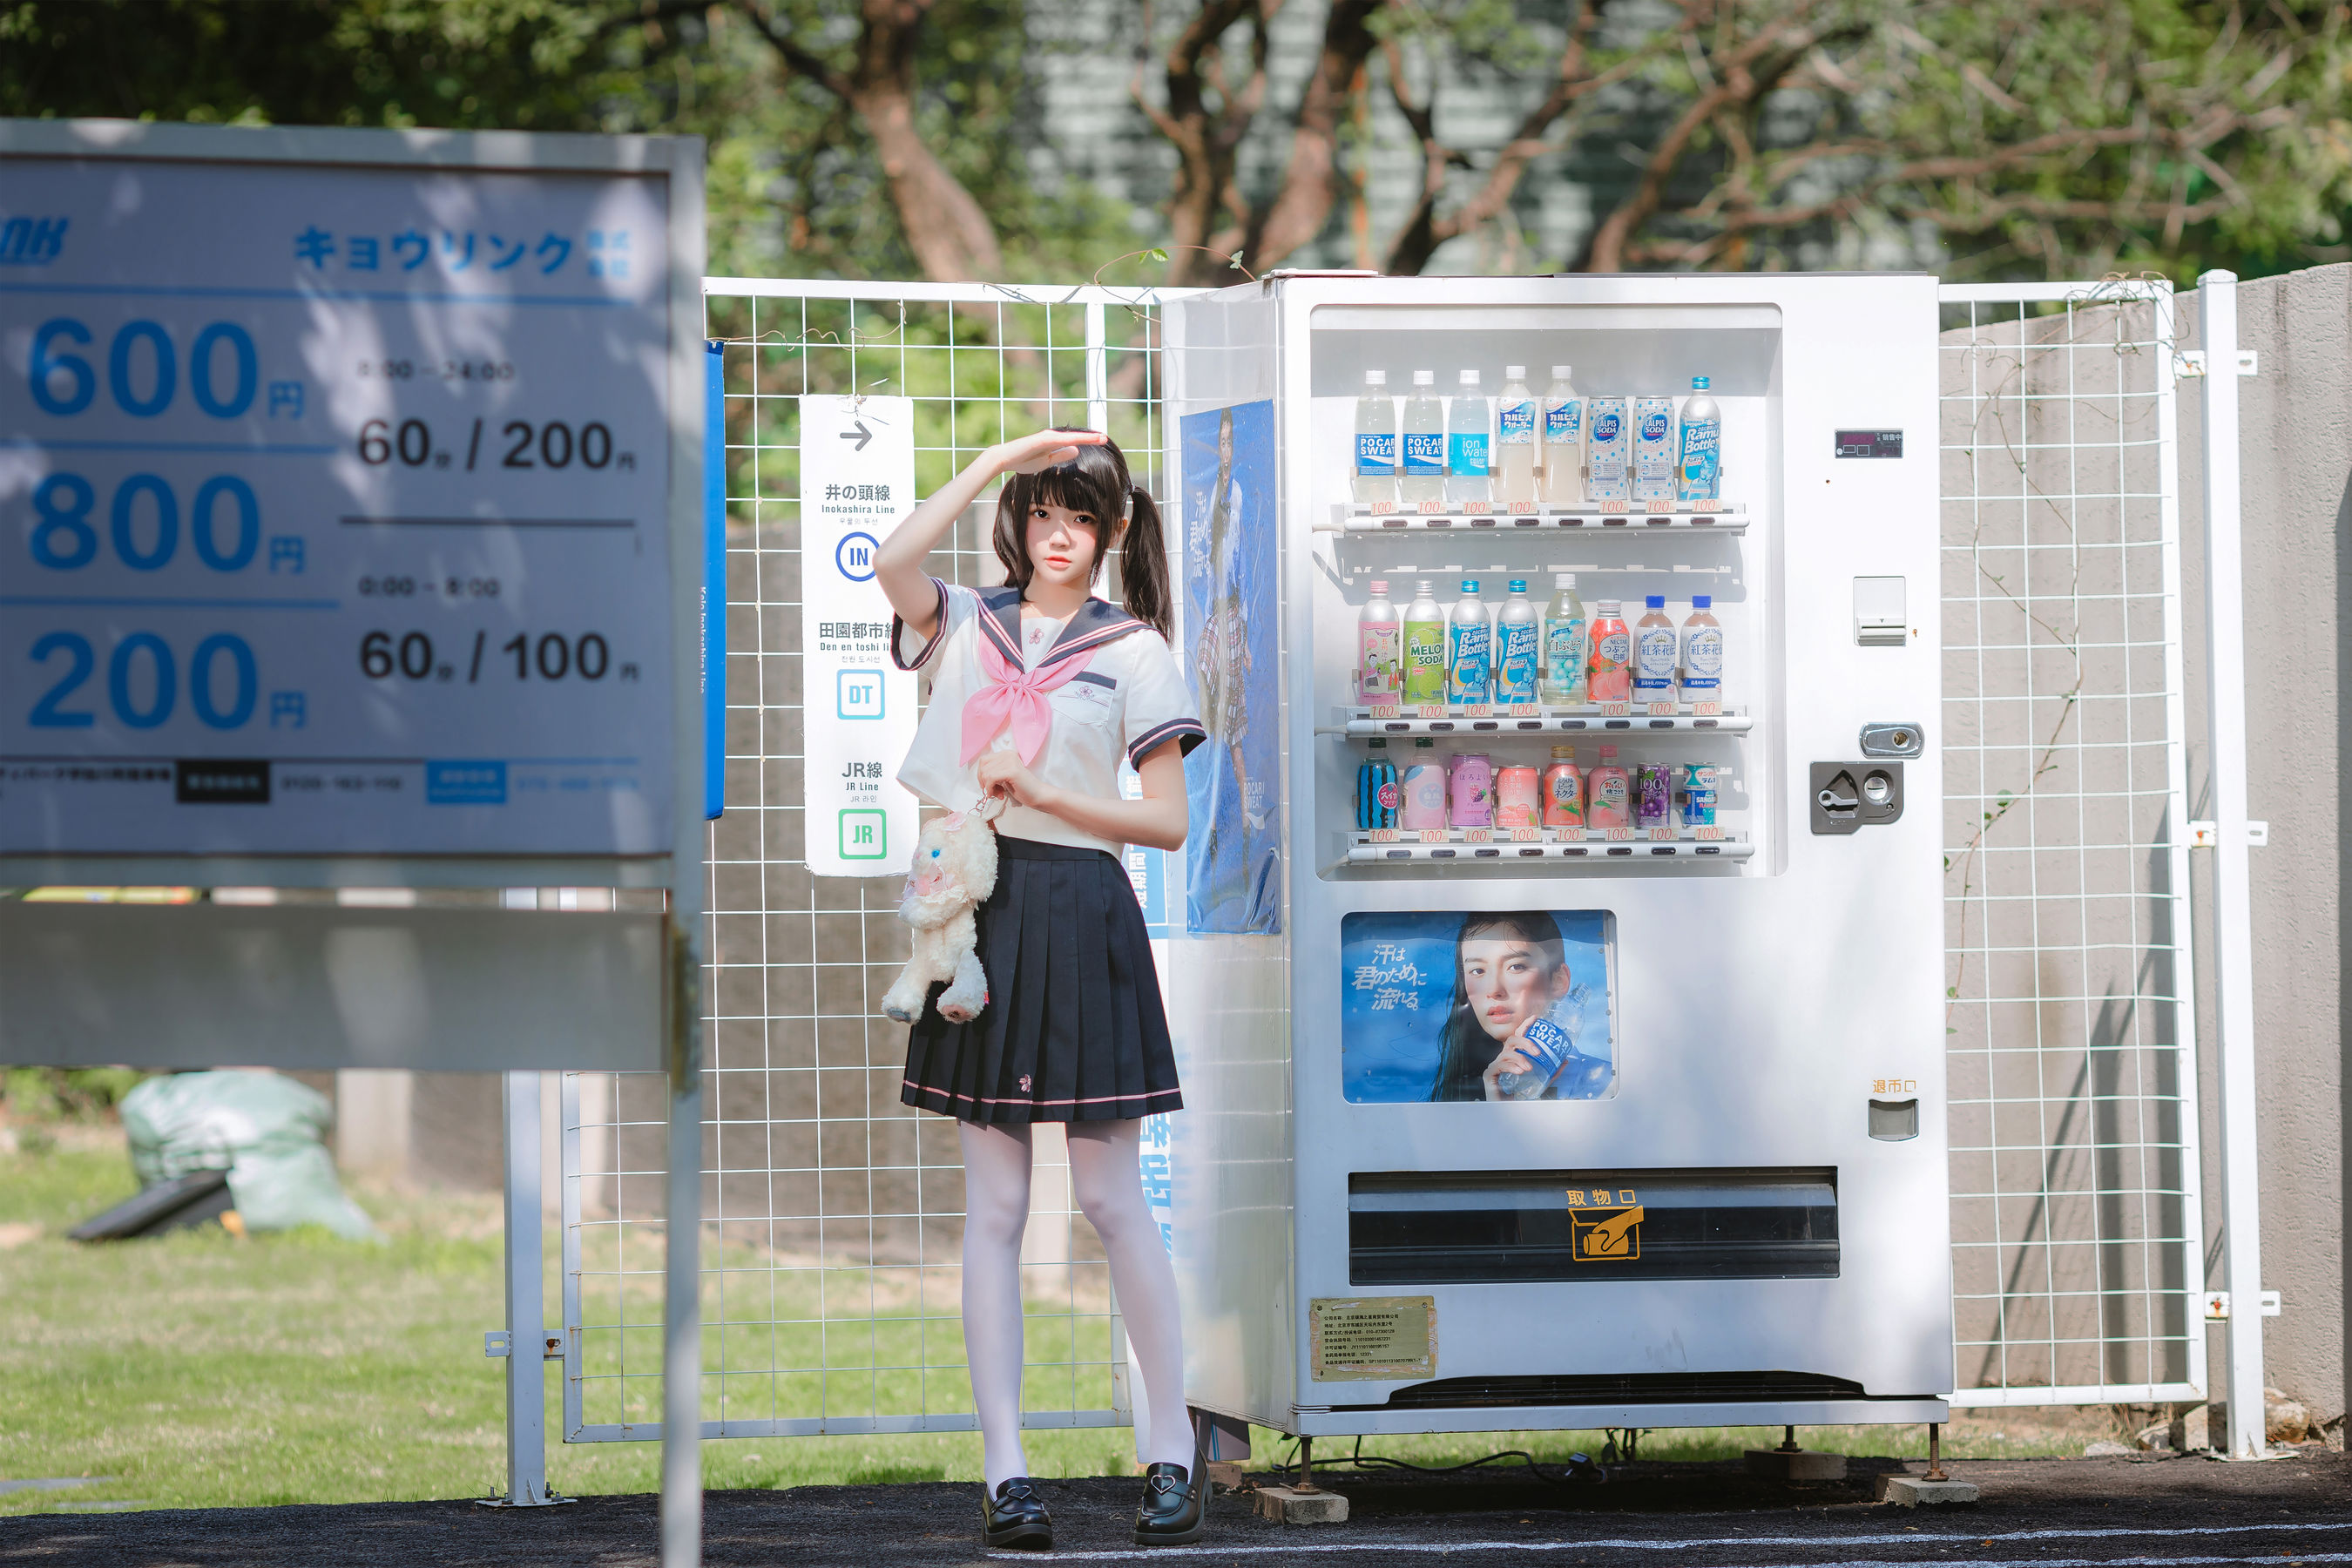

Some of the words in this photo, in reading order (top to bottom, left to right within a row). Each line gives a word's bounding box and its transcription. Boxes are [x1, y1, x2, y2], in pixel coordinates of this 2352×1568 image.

[294, 225, 572, 275] キョウリンク
[1597, 419, 1617, 428] CALPIS
[1645, 419, 1665, 428] CALPIS
[1463, 437, 1480, 449] ion
[1685, 438, 1716, 455] Bottle
[826, 483, 890, 502] 井の頭線
[821, 504, 872, 514] Inokashira
[875, 505, 896, 514] Line
[849, 548, 868, 566] IN
[820, 642, 837, 651] Den
[856, 643, 879, 652] toshi
[1457, 642, 1488, 658] Bottle
[1549, 639, 1582, 652] 白ぶどう
[1418, 656, 1443, 665] SODA
[849, 686, 873, 704] DT
[841, 761, 882, 779] JR線
[846, 782, 855, 791] JR
[860, 782, 879, 791] Line
[1243, 781, 1265, 795] POCARI
[1555, 789, 1577, 799] ネクター
[1243, 795, 1263, 809] SWEAT
[853, 825, 873, 844] JR
[1371, 943, 1406, 965] 汗は
[1351, 963, 1428, 990] 君のために
[1529, 1028, 1566, 1057] SWEAT
[1873, 1079, 1916, 1093] 退币口
[1566, 1188, 1637, 1206] 取物口
